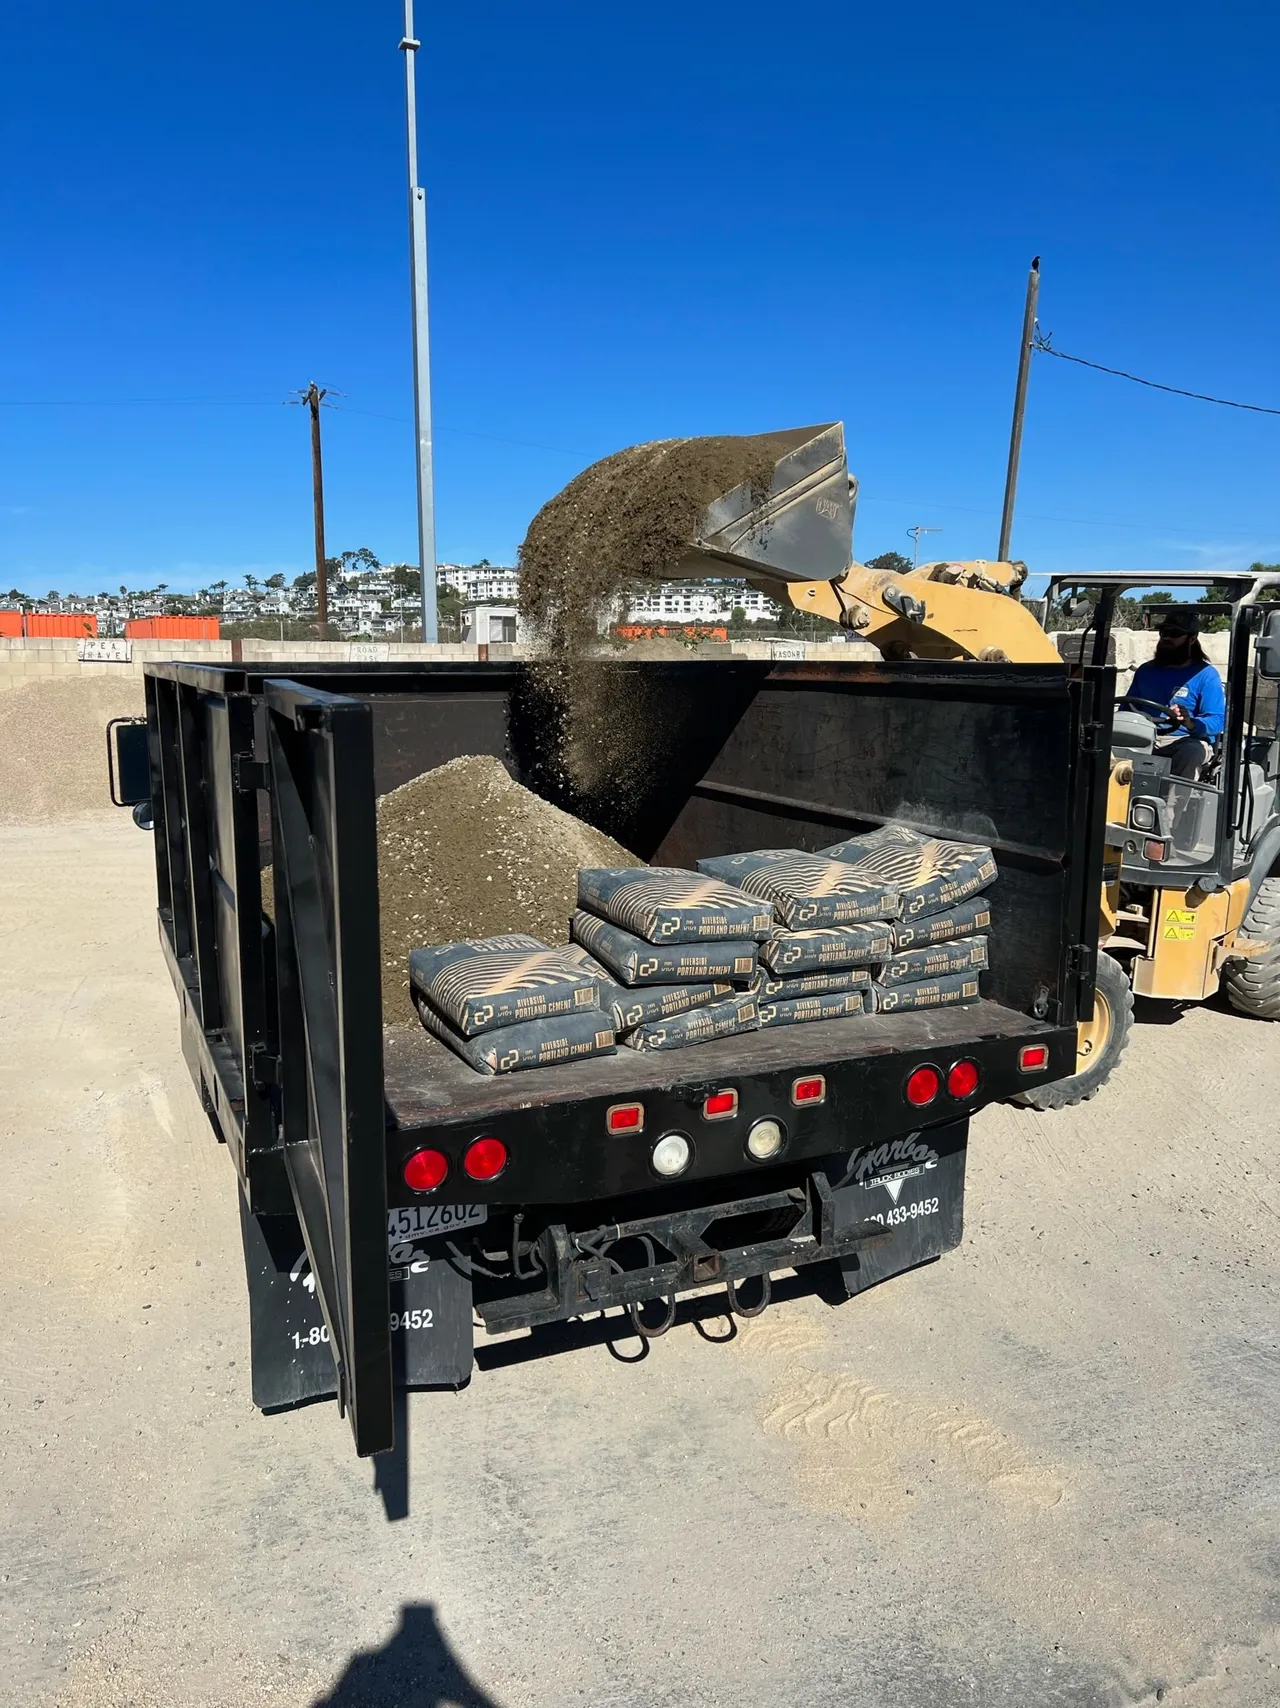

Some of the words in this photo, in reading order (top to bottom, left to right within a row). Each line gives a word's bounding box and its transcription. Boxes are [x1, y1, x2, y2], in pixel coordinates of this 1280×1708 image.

[88, 641, 116, 650] PEA
[356, 646, 378, 654] ROAD
[78, 650, 130, 660] GRAVEL
[961, 878, 980, 894] CEMENT
[834, 907, 859, 919] PORTLAND
[860, 904, 880, 917] CEMENT
[702, 916, 728, 925] RIVERSIDE
[931, 920, 954, 930] RIVERSIDE
[699, 925, 728, 935] PORTLAND
[729, 924, 750, 934] CEMENT
[930, 927, 954, 940] PORTLAND
[955, 923, 973, 934] CEMENT
[821, 942, 846, 952] RIVERSIDE
[681, 957, 708, 966] RIVERSIDE
[819, 951, 846, 962] PORTLAND
[847, 949, 868, 958] CEMENT
[926, 953, 948, 964] RIVERSIDE
[677, 966, 707, 976] PORTLAND
[708, 965, 731, 975] CEMENT
[924, 961, 949, 974] PORTLAND
[950, 957, 968, 968] CEMENT
[800, 980, 828, 991] PORTLAND
[829, 977, 849, 987] CEMENT
[917, 986, 940, 996] RIVERSIDE
[517, 994, 546, 1008] RIVERSIDE
[661, 998, 690, 1015] PORTLAND
[690, 990, 712, 1004] CEMENT
[663, 988, 688, 1003] RIVERSIDE
[915, 994, 940, 1006] PORTLAND
[941, 991, 960, 1001] CEMENT
[515, 1004, 547, 1018] PORTLAND
[548, 1000, 572, 1012] CEMENT
[794, 1008, 820, 1020] PORTLAND
[822, 1004, 843, 1016] CEMENT
[796, 1000, 820, 1010] RIVERSIDE
[685, 1025, 715, 1040] PORTLAND
[715, 1018, 735, 1032] CEMENT
[687, 1016, 713, 1029] RIVERSIDE
[541, 1038, 569, 1051] RIVERSIDE
[539, 1049, 570, 1062] PORTLAND
[570, 1042, 593, 1054] CEMENT
[869, 1173, 894, 1187] TRUCK
[893, 1166, 920, 1179] BODIES
[886, 1197, 939, 1227] 433-9452
[405, 1222, 462, 1239] dmv.ca.gov
[291, 1325, 330, 1350] 1-80
